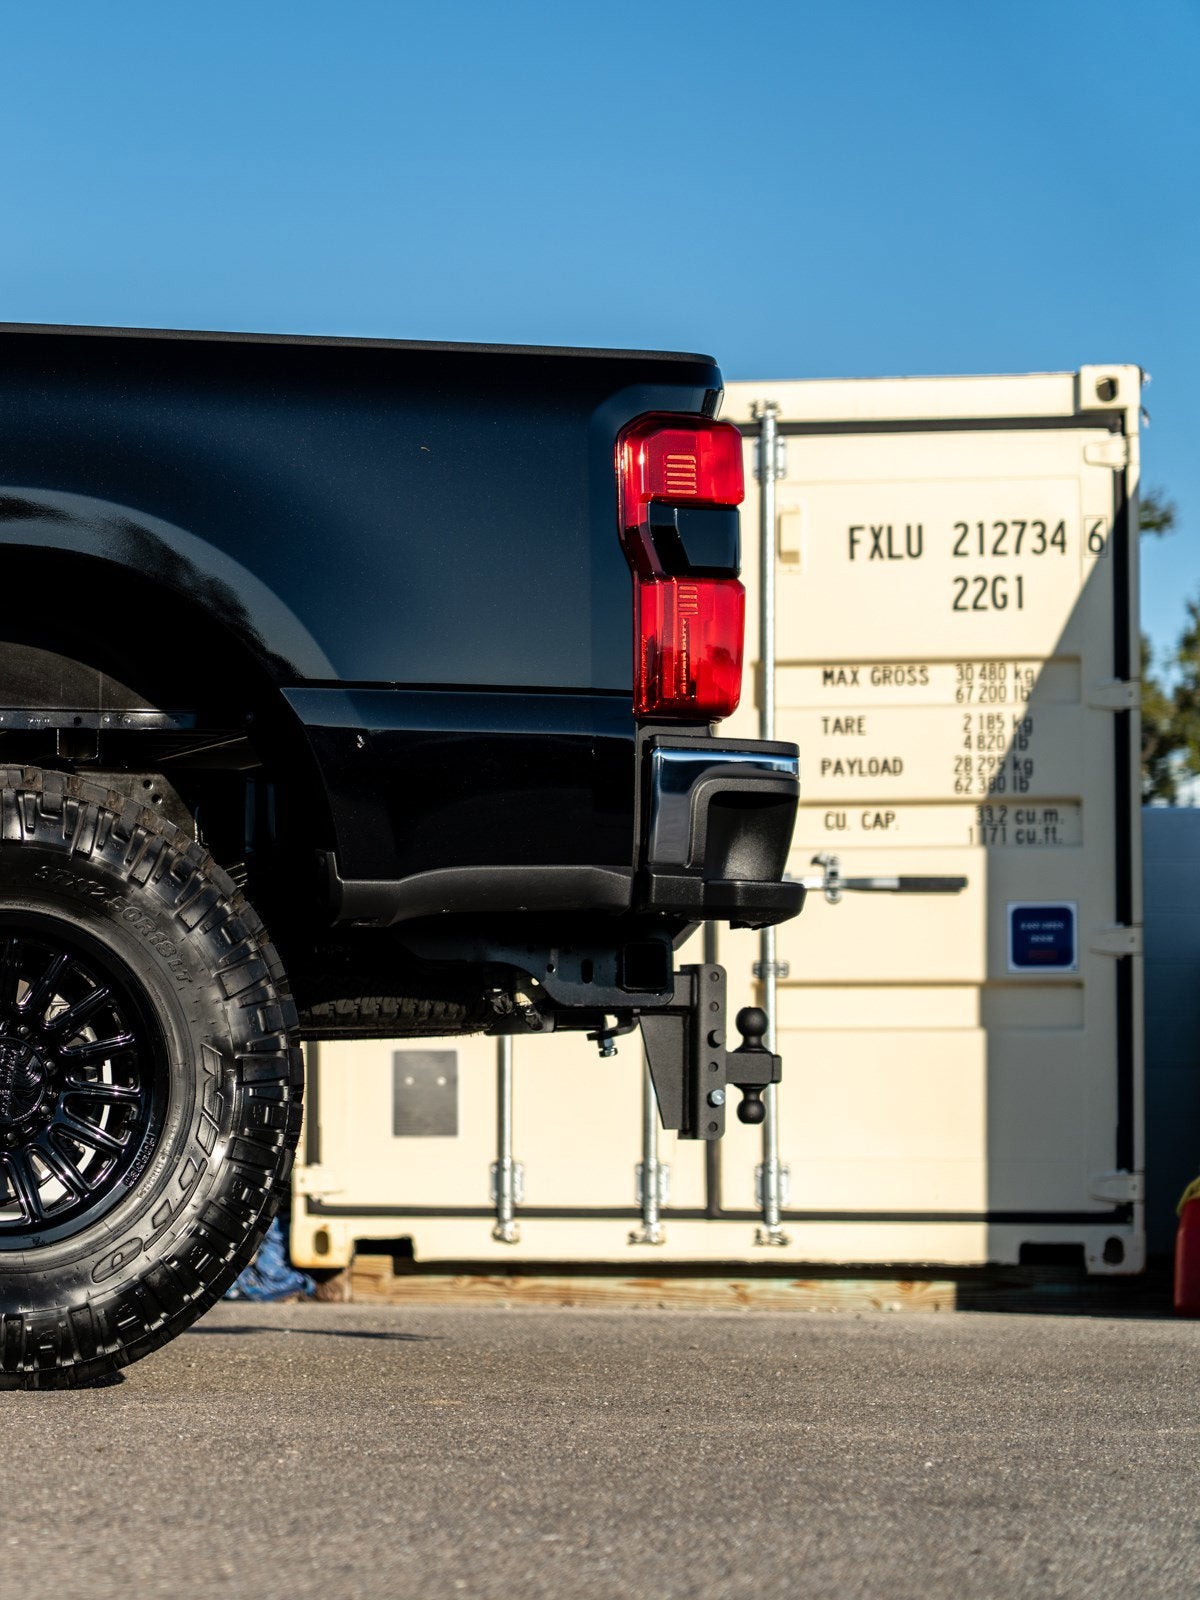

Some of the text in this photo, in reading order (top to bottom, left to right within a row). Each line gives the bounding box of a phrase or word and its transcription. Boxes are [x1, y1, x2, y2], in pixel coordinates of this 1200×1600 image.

[848, 519, 1106, 560] FXLU 212734 6
[952, 574, 1024, 612] 22G1
[822, 667, 860, 687] MAX
[870, 665, 930, 687] GROSS
[1014, 662, 1035, 689] kg
[821, 715, 867, 736] TARE
[1012, 713, 1034, 737] kg
[1012, 731, 1029, 752] lb
[821, 756, 904, 777] PAYLOAD
[1012, 755, 1034, 780] kg
[1012, 774, 1030, 794] lb
[91, 1042, 225, 1284] NITTO
